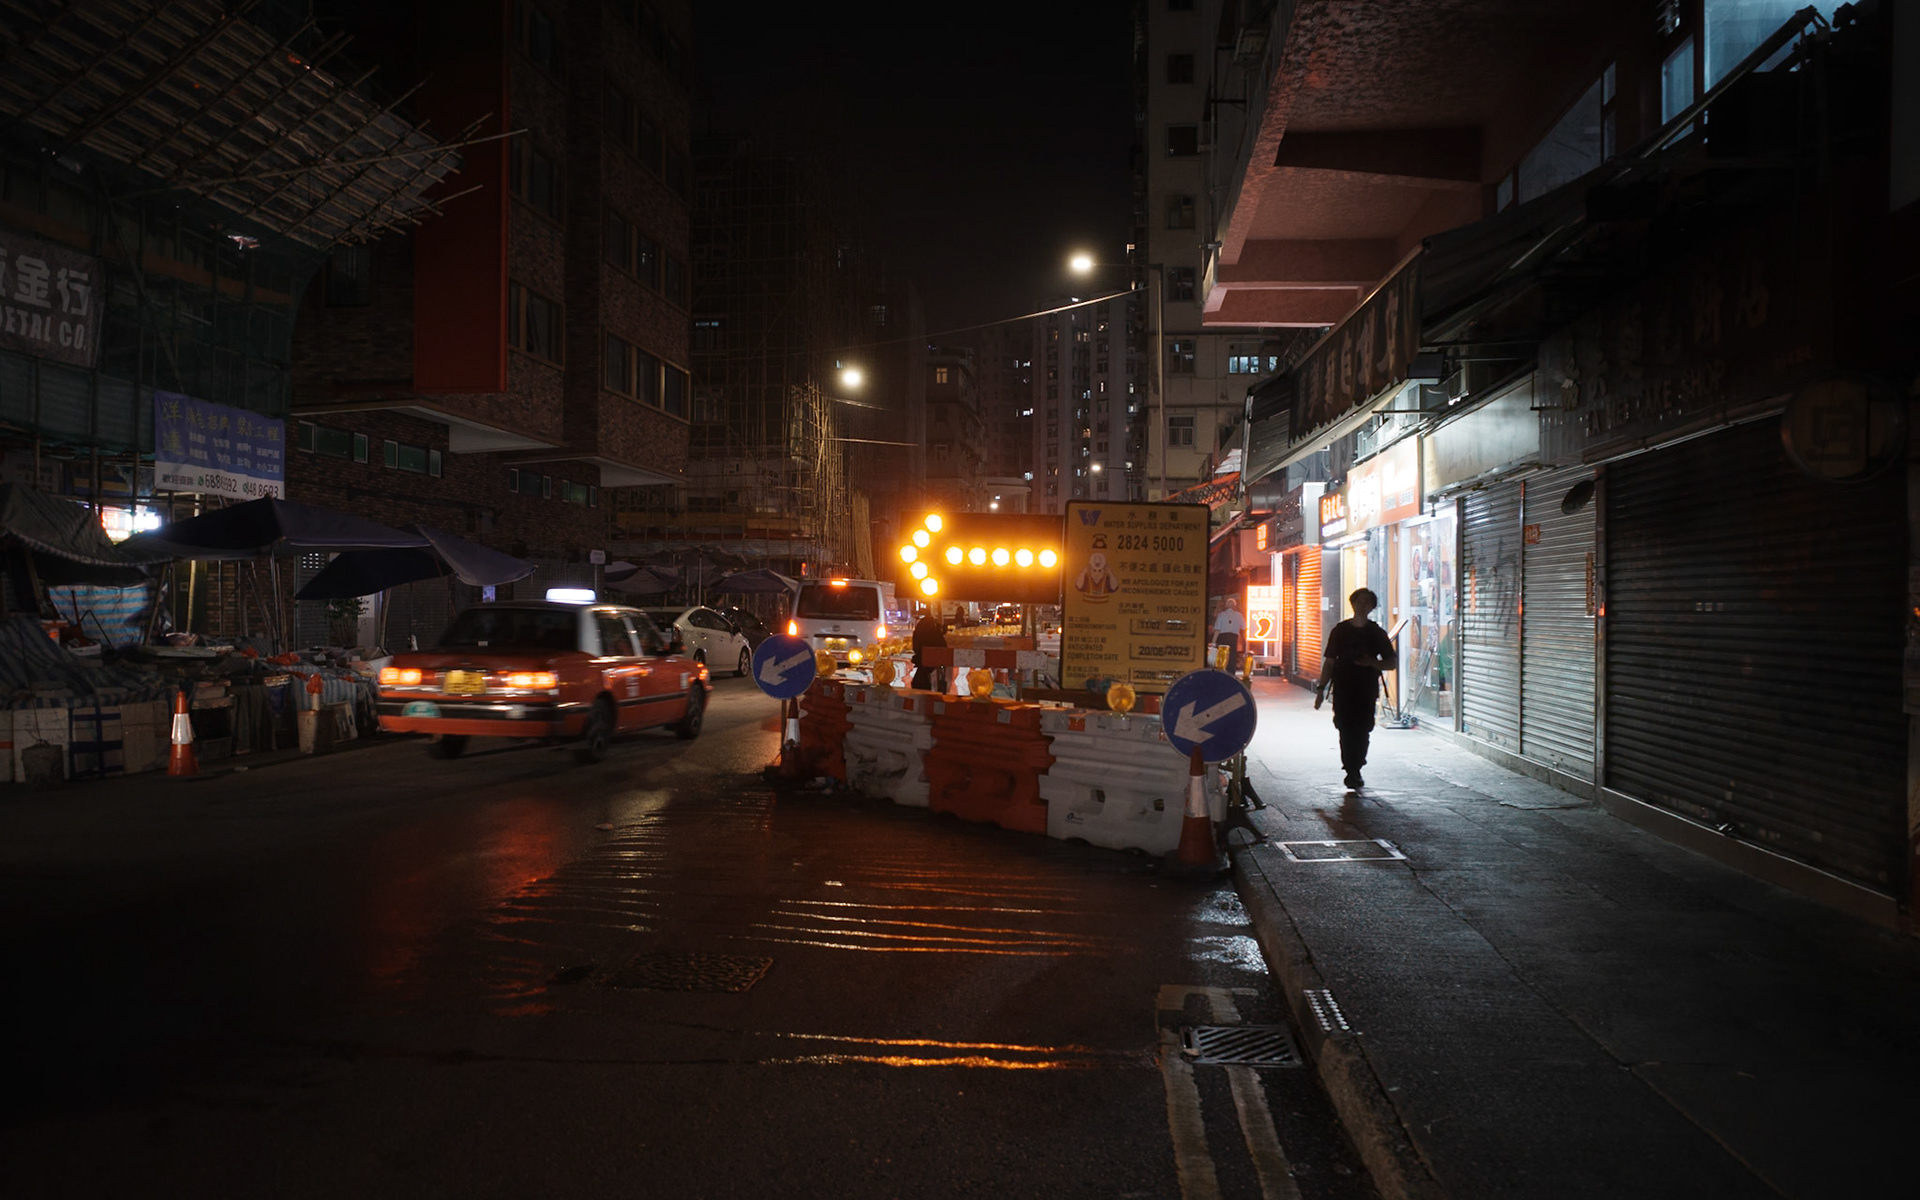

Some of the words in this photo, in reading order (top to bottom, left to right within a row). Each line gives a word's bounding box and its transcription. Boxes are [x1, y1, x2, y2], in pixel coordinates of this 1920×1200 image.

[0, 247, 92, 316] 金行
[0, 303, 52, 343] ETAL
[59, 320, 87, 351] CO.
[1681, 358, 1725, 397] SHOP
[1103, 520, 1125, 529] WATER
[1127, 521, 1157, 530] SUPPLIES
[1159, 522, 1201, 531] DEPARTMENT
[1117, 534, 1148, 550] 2824
[1153, 535, 1184, 551] 5000
[1171, 579, 1184, 587] FOR
[1185, 580, 1199, 588] ANY
[1121, 587, 1172, 596] INCONVENIENCE
[1173, 588, 1199, 597] CAUSED
[1067, 651, 1103, 661] COMPLETION
[1104, 653, 1119, 661] DATE
